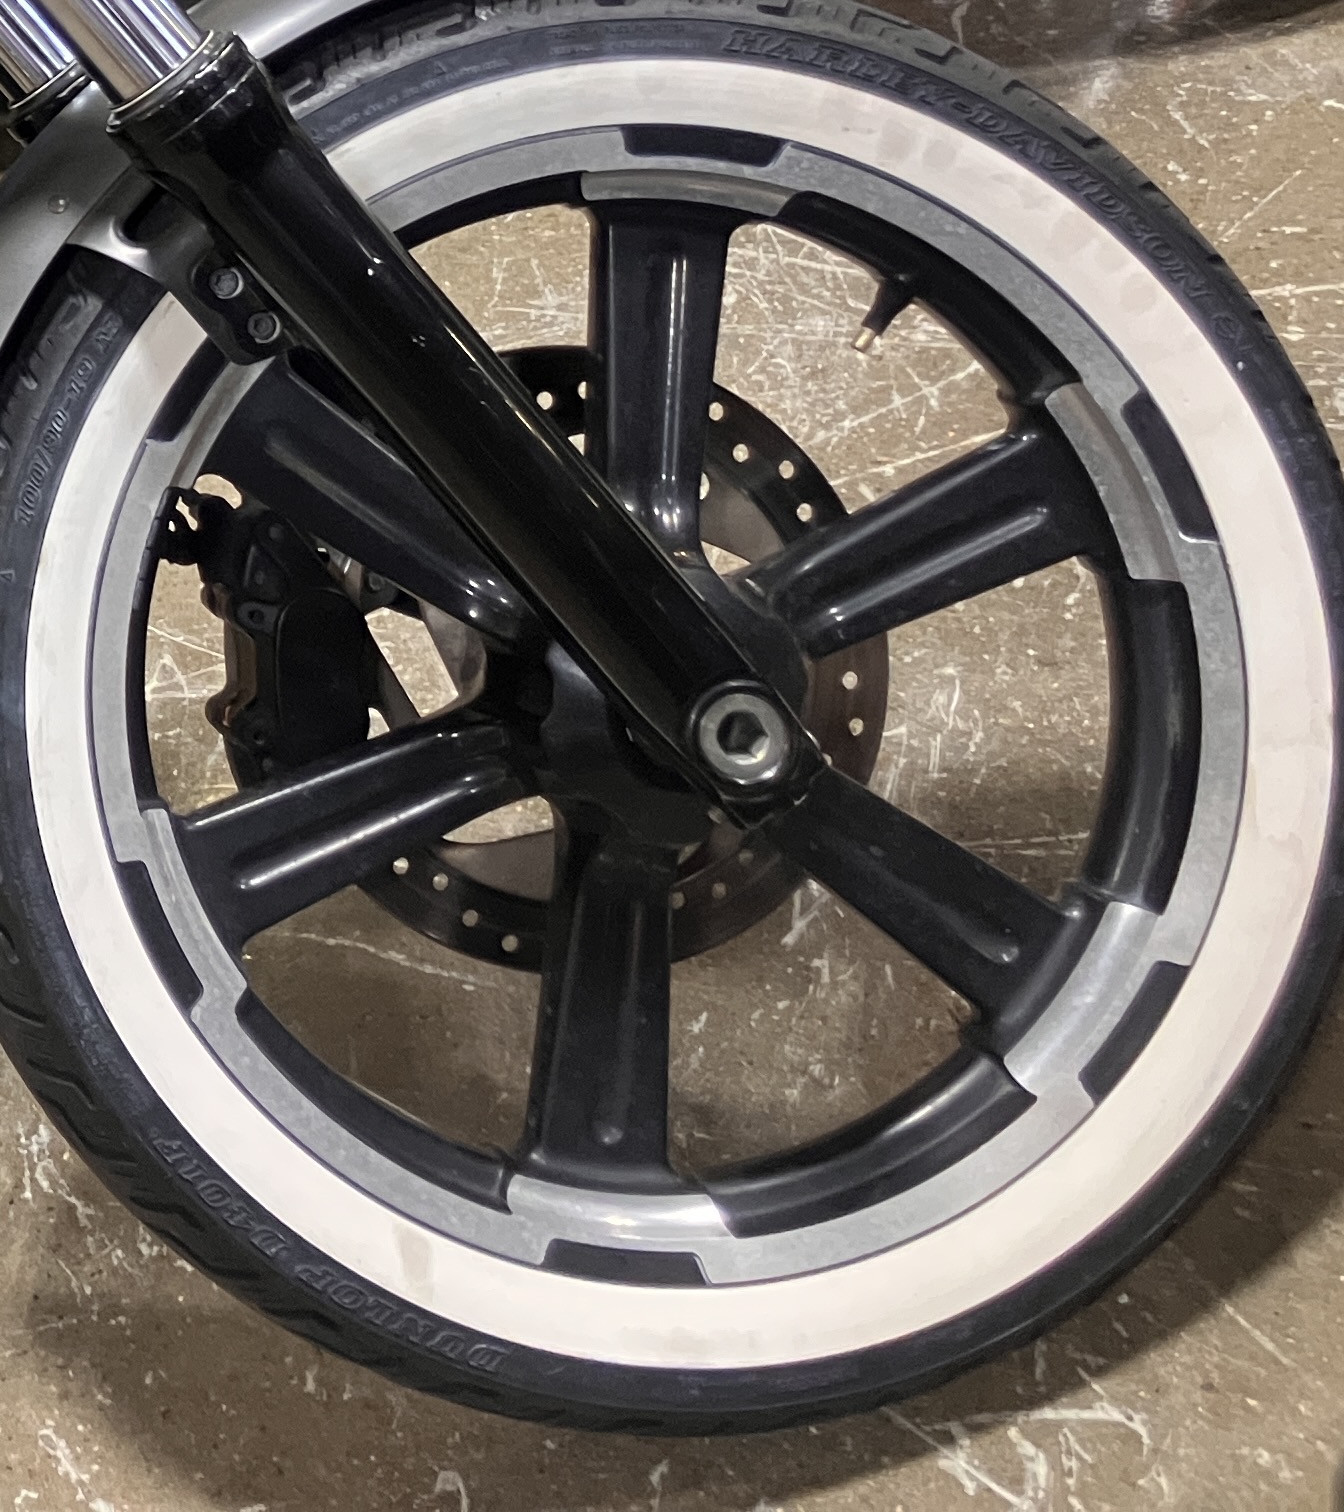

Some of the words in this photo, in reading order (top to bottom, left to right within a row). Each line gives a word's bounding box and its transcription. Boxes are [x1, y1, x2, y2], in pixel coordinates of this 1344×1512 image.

[720, 26, 1213, 302] HARLEY-DAVIDSON
[13, 356, 96, 527] 100/90-19
[152, 1137, 289, 1259] D401F
[293, 1263, 511, 1373] DUNLOP
